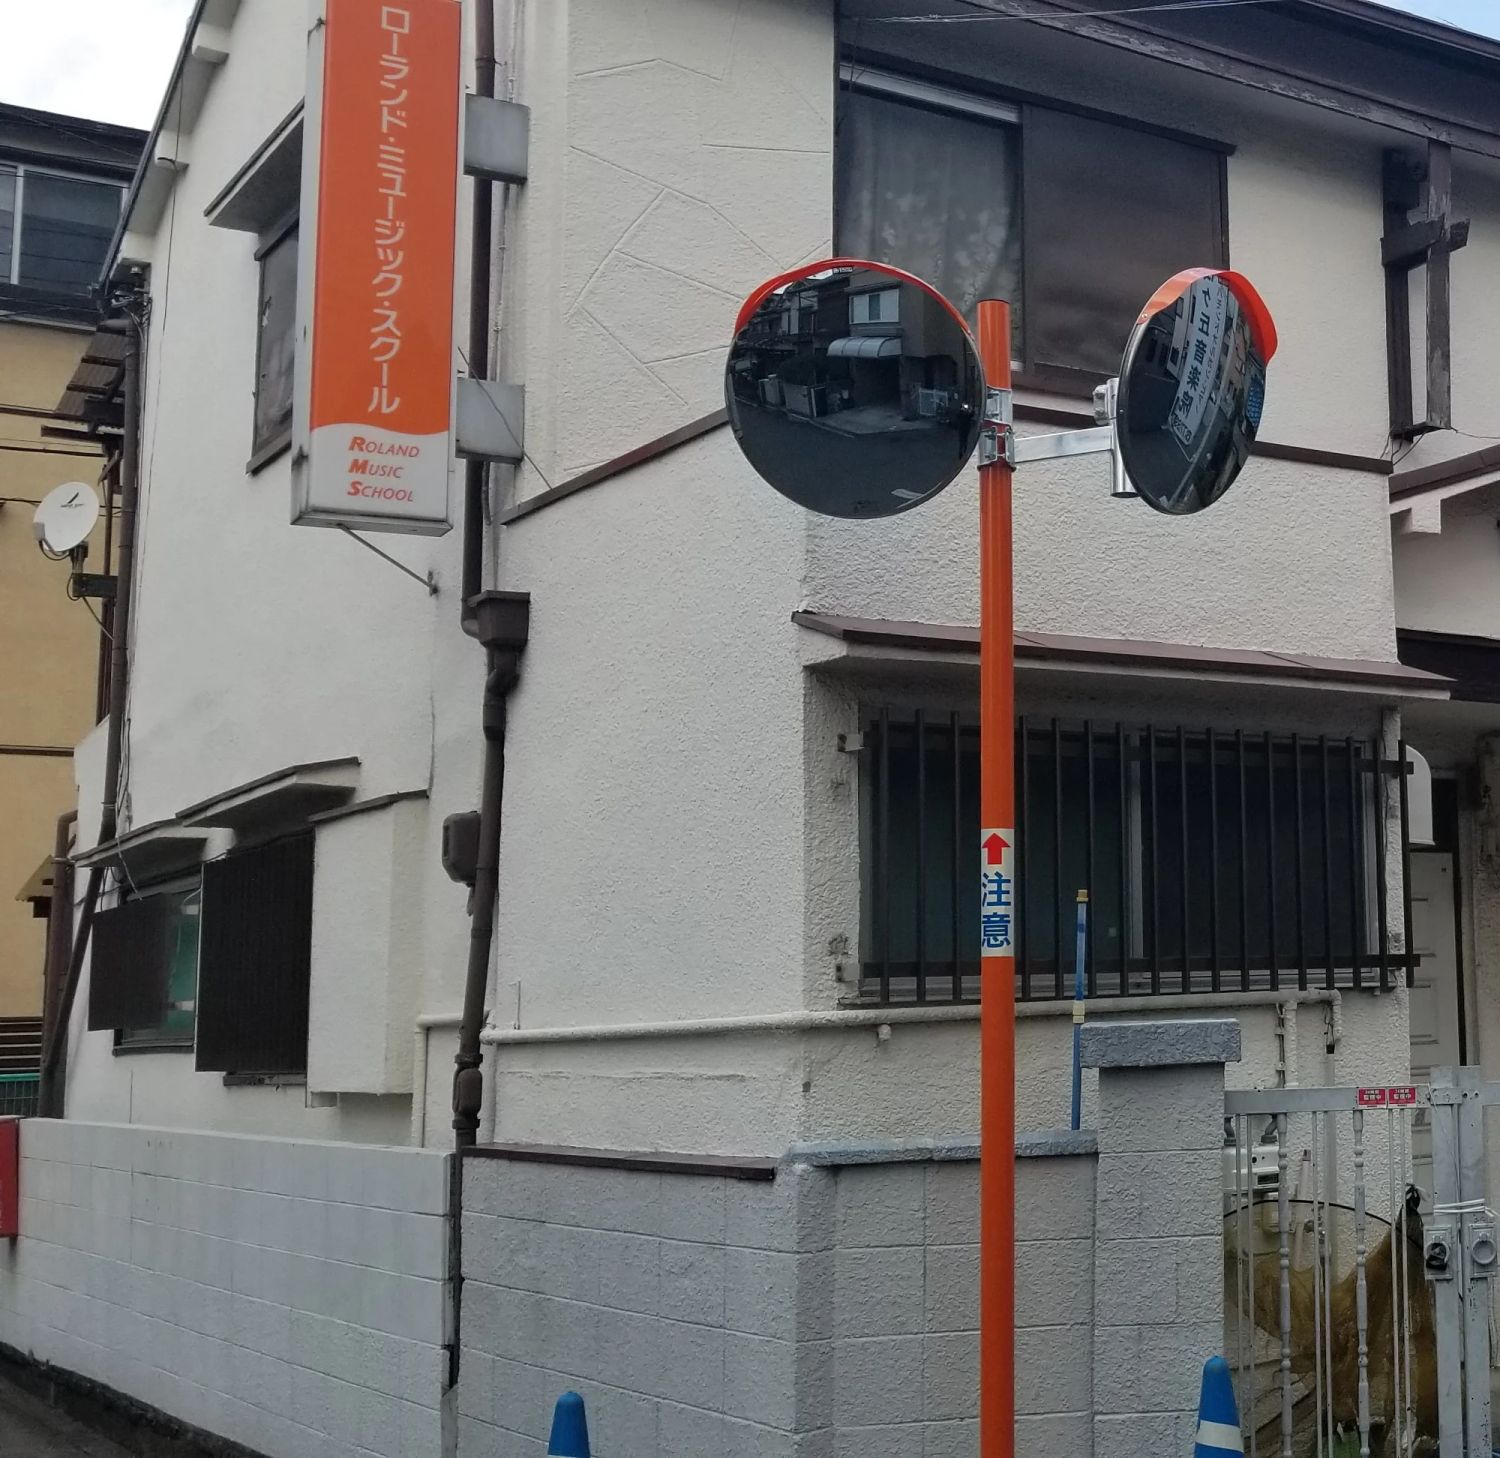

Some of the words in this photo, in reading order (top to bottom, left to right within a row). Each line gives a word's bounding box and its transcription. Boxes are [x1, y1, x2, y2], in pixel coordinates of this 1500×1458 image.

[367, 5, 411, 415] ローランド・ミュージック・スクール
[348, 435, 420, 458] ROLAND
[347, 458, 405, 480] MUSIC
[346, 480, 415, 503] SCHOOL
[981, 870, 1012, 948] 注意
